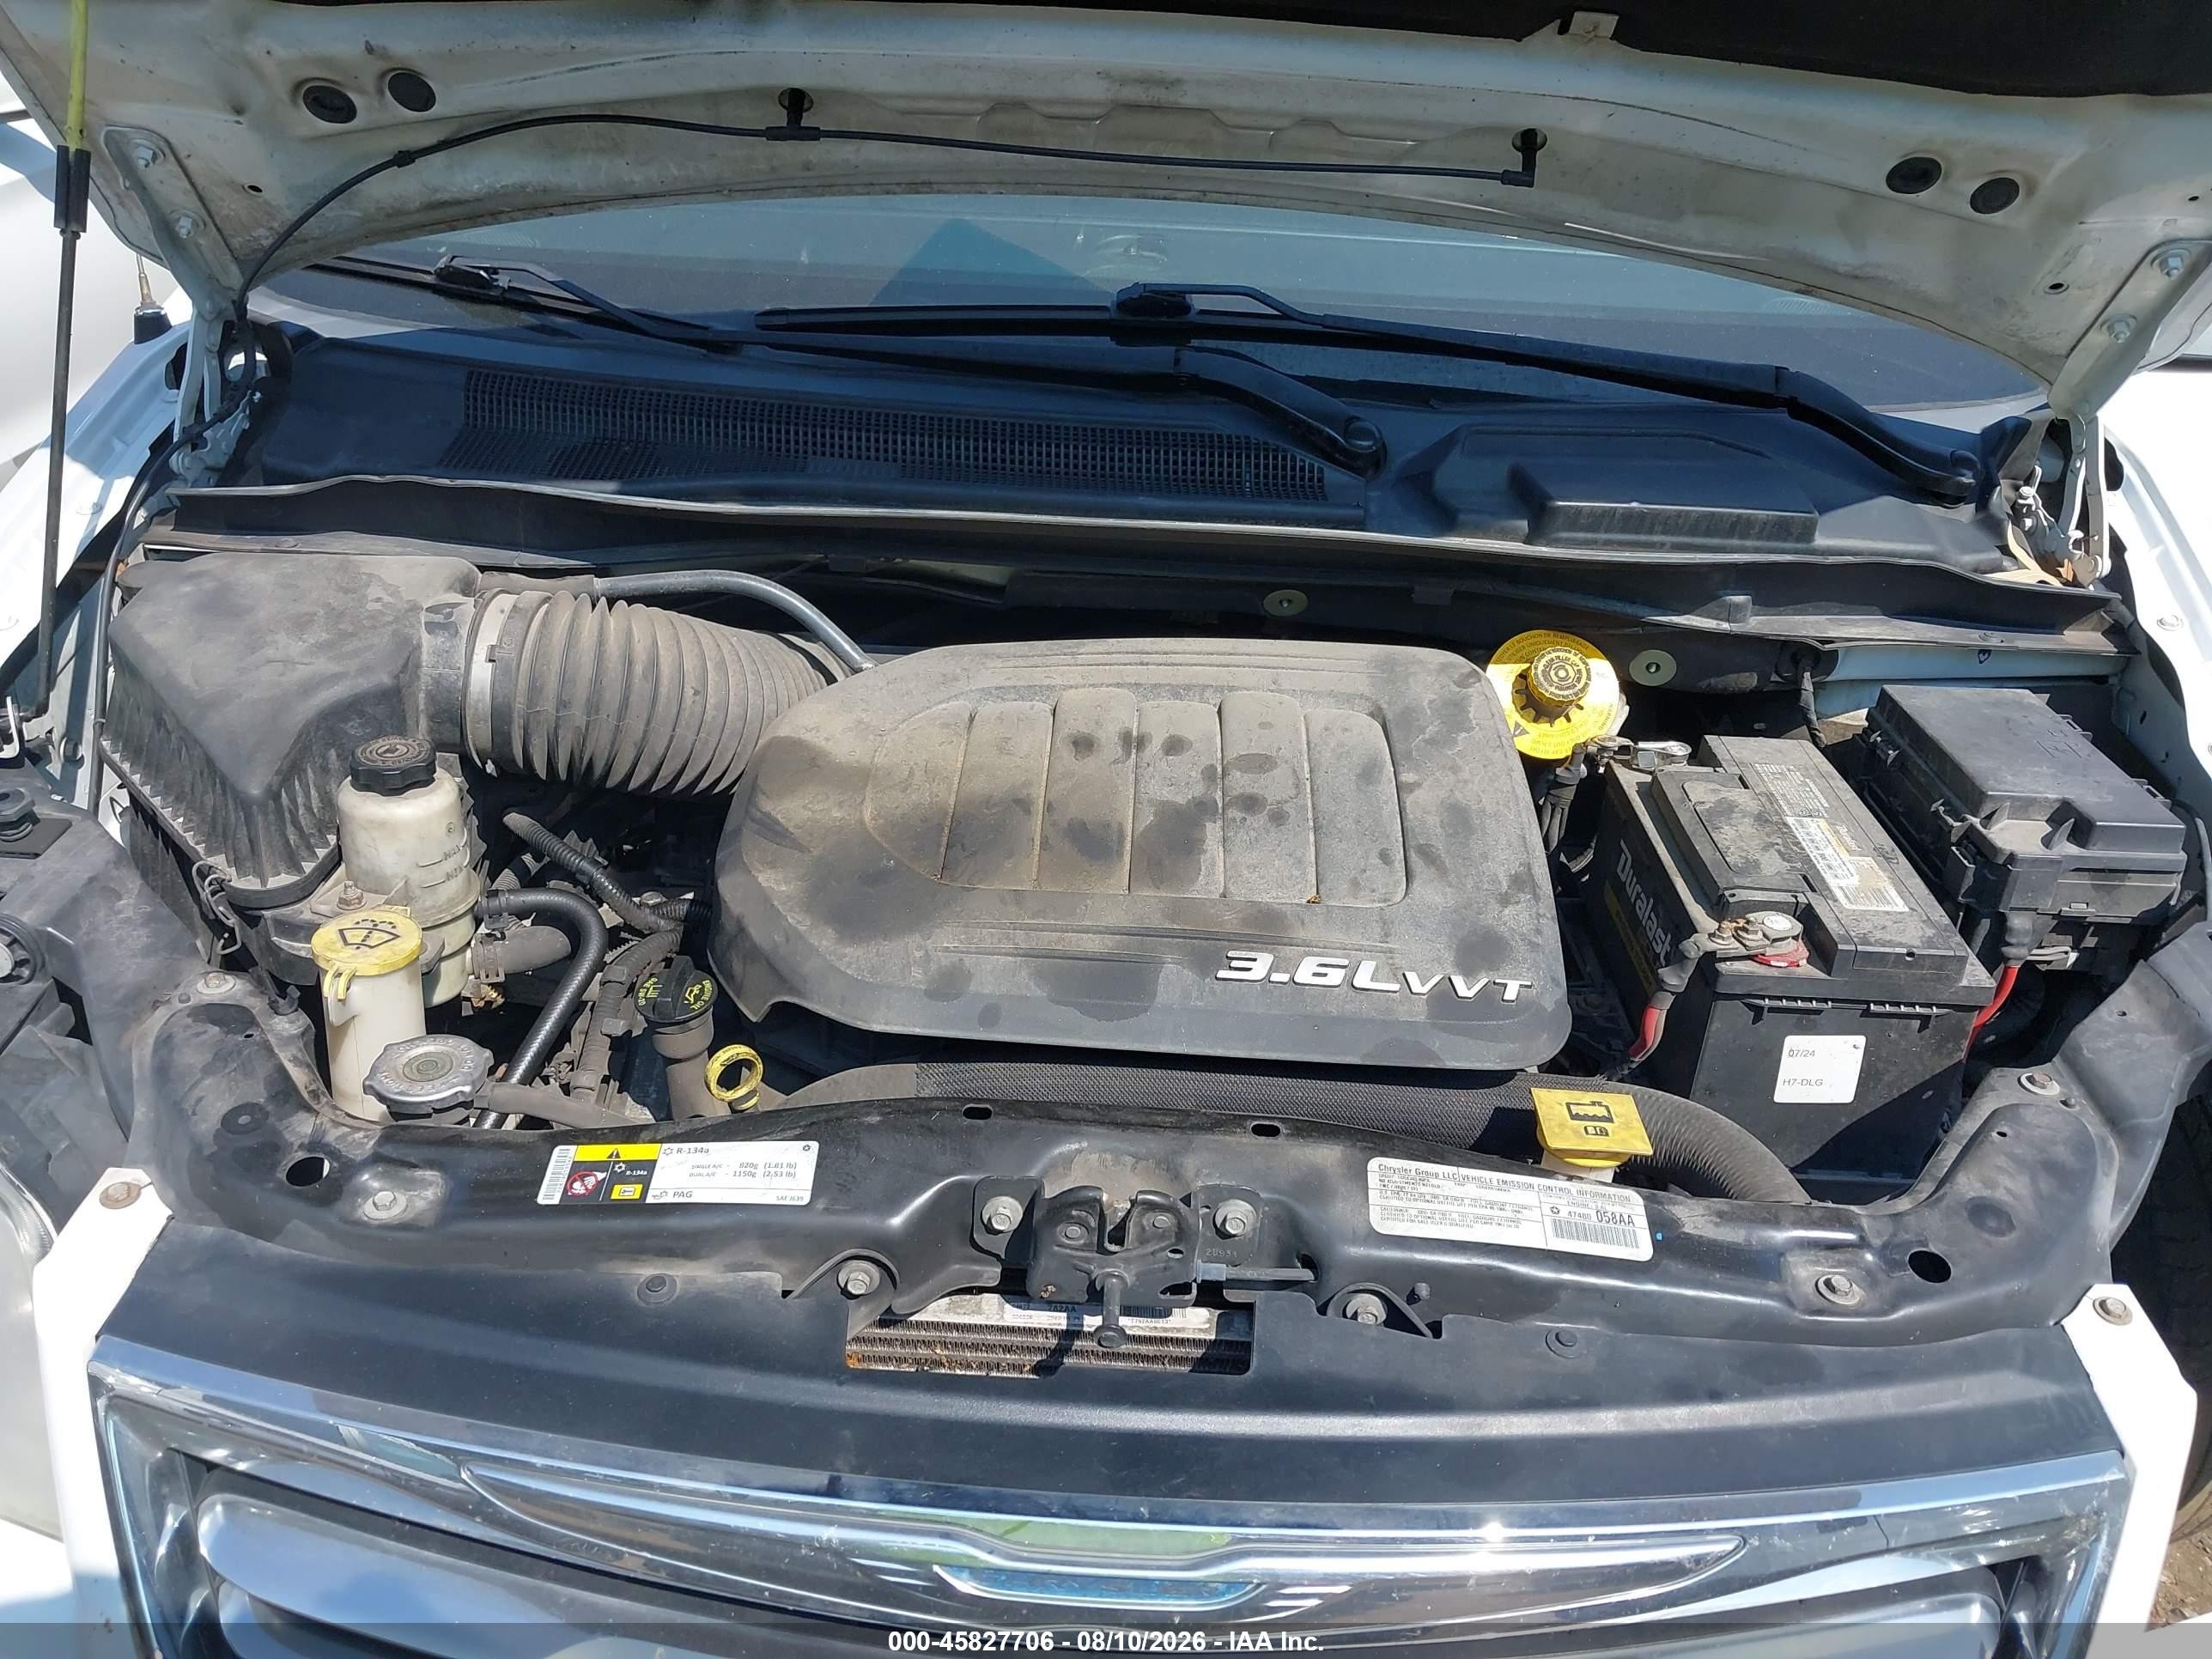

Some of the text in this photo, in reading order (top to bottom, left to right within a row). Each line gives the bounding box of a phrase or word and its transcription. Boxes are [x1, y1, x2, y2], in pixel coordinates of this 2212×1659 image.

[1617, 839, 1671, 967] Duralast
[1215, 950, 1533, 1003] 3.6L VVT
[690, 980, 713, 1011] ENGINE OIL
[1789, 1049, 1816, 1058] 07/24
[1378, 1164, 1457, 1180] Chrysler Group LLC
[1461, 1174, 1493, 1184] VEHICLE
[1496, 1179, 1535, 1190] EMISSION
[1538, 1184, 1574, 1195] CONTROL
[1577, 1188, 1632, 1202] INFORMATION
